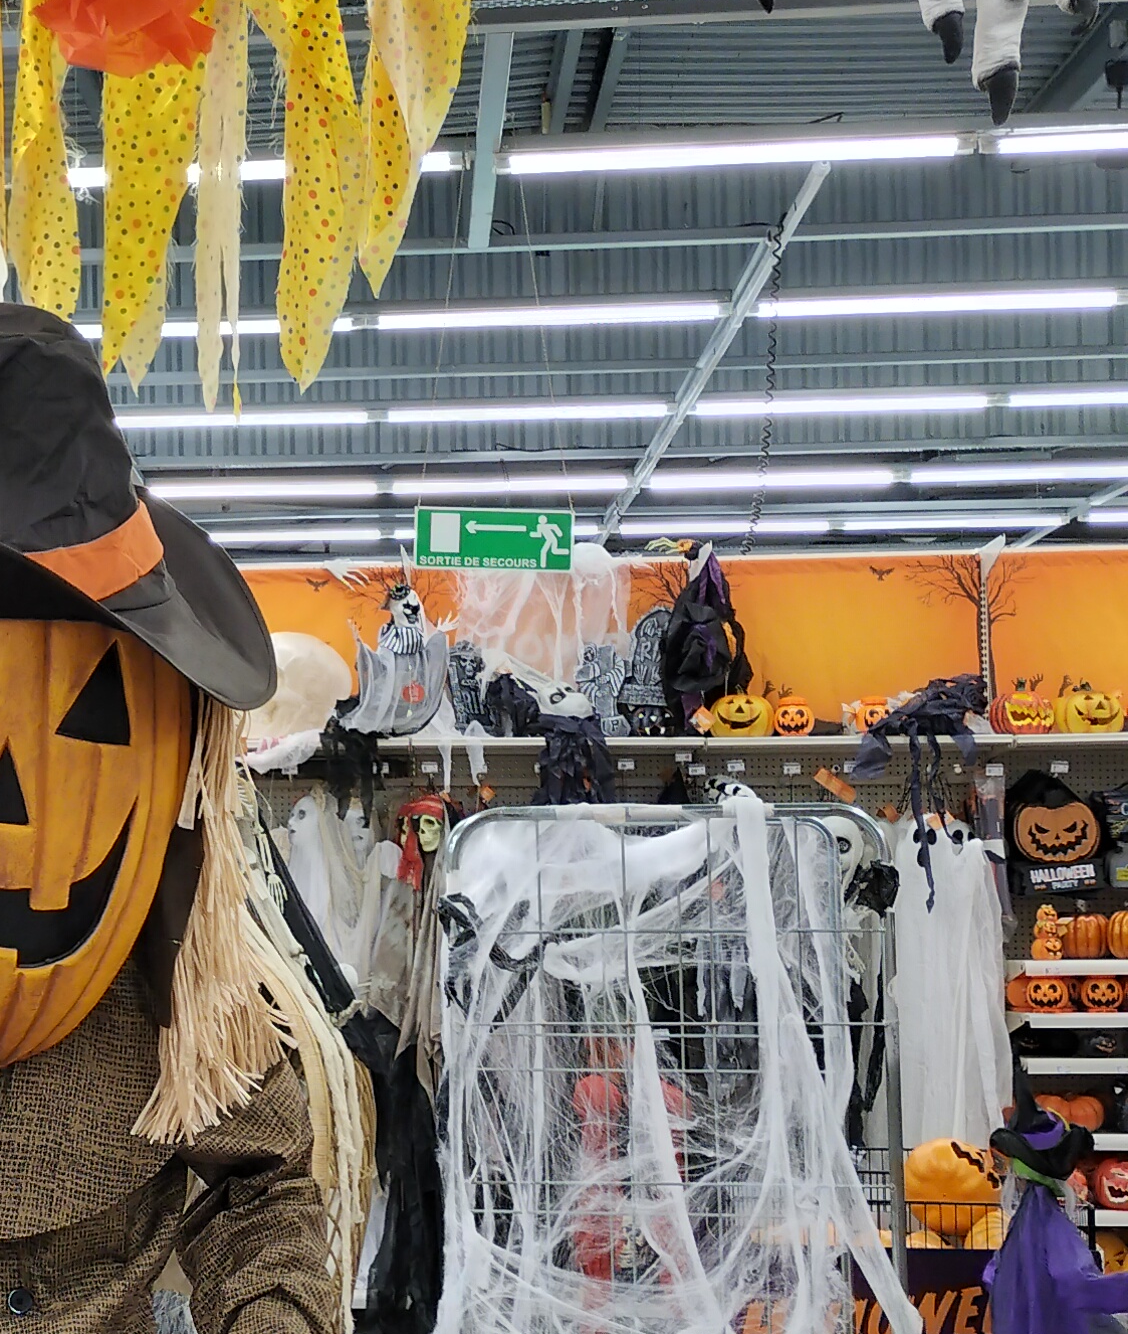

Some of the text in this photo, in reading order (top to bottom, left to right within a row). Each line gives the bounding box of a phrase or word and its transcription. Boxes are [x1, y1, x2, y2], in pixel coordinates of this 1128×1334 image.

[419, 555, 537, 568] SORTIE DE SECOURS
[1029, 863, 1096, 884] HALLOWEEN
